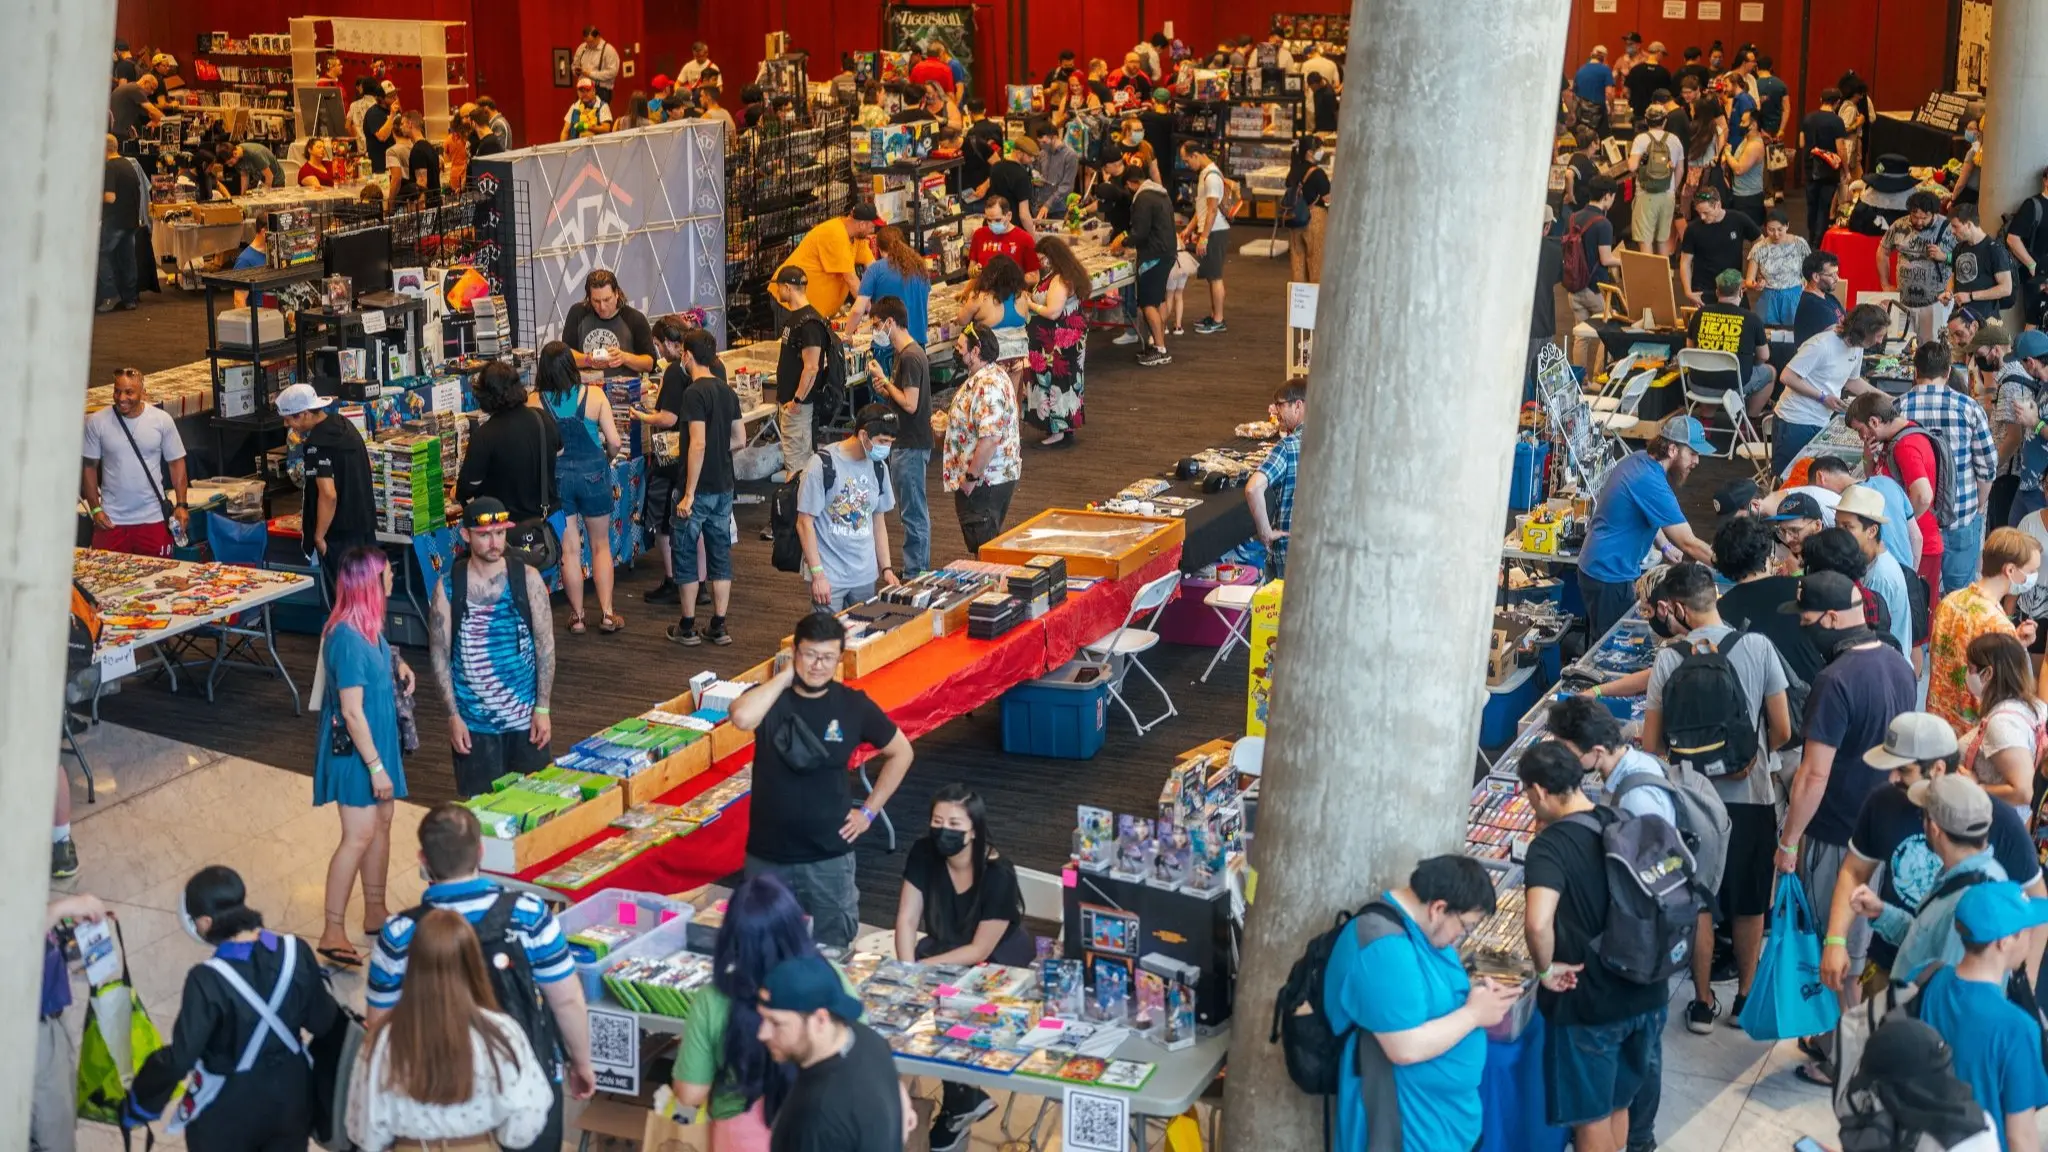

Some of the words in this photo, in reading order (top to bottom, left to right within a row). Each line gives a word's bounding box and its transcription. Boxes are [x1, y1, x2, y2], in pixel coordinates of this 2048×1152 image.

[1699, 321, 1742, 336] HEAD
[1698, 338, 1739, 353] YOU'RE
[1255, 603, 1276, 613] Good
[596, 1074, 614, 1085] CAN
[615, 1077, 629, 1088] ME
